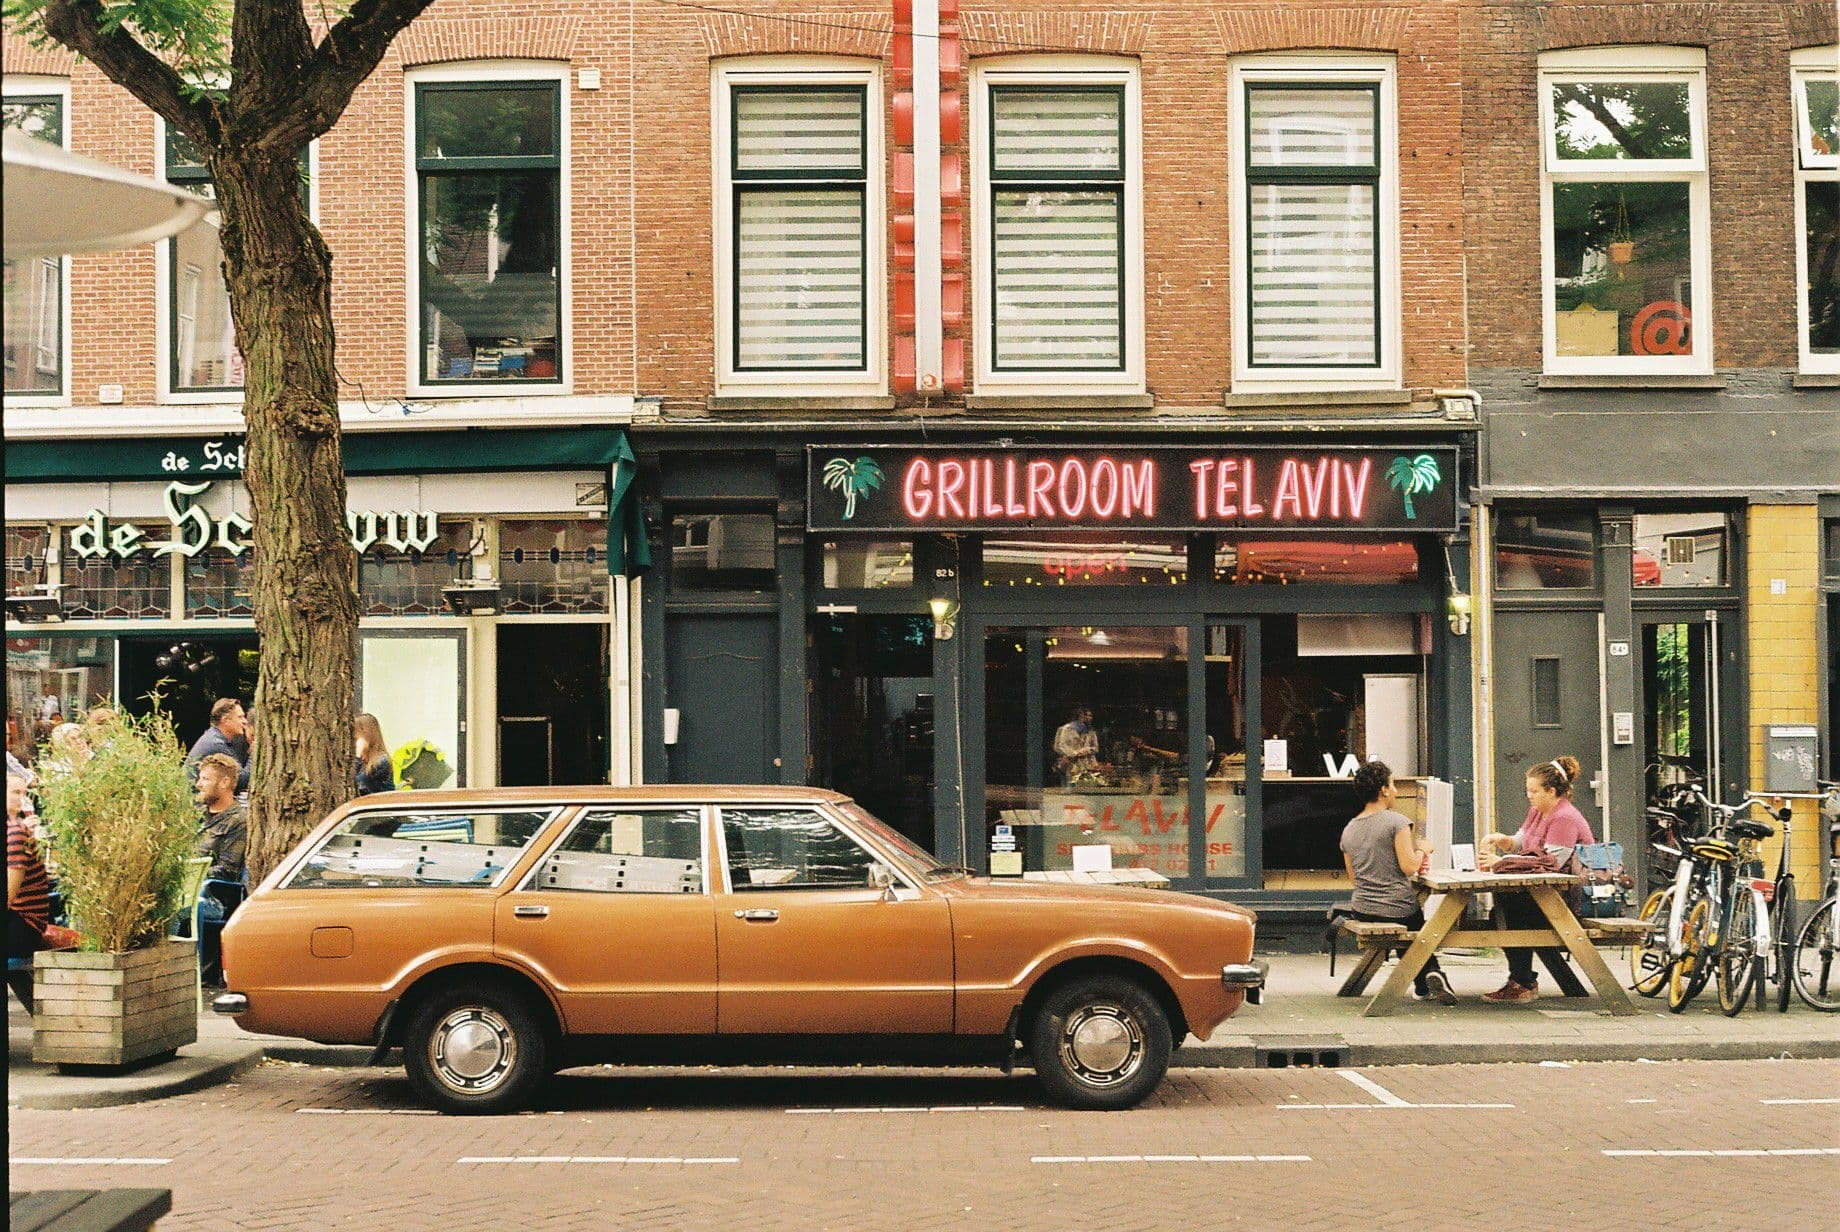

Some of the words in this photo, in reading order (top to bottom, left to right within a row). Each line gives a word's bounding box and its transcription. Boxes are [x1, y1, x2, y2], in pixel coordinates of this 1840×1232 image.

[161, 451, 189, 471] de
[905, 458, 1155, 519] GRILLROOM
[1190, 458, 1264, 519] TEL
[1272, 456, 1372, 519] AVIV
[71, 509, 145, 558] de
[1044, 553, 1127, 579] open
[1167, 842, 1233, 855] HOSE
